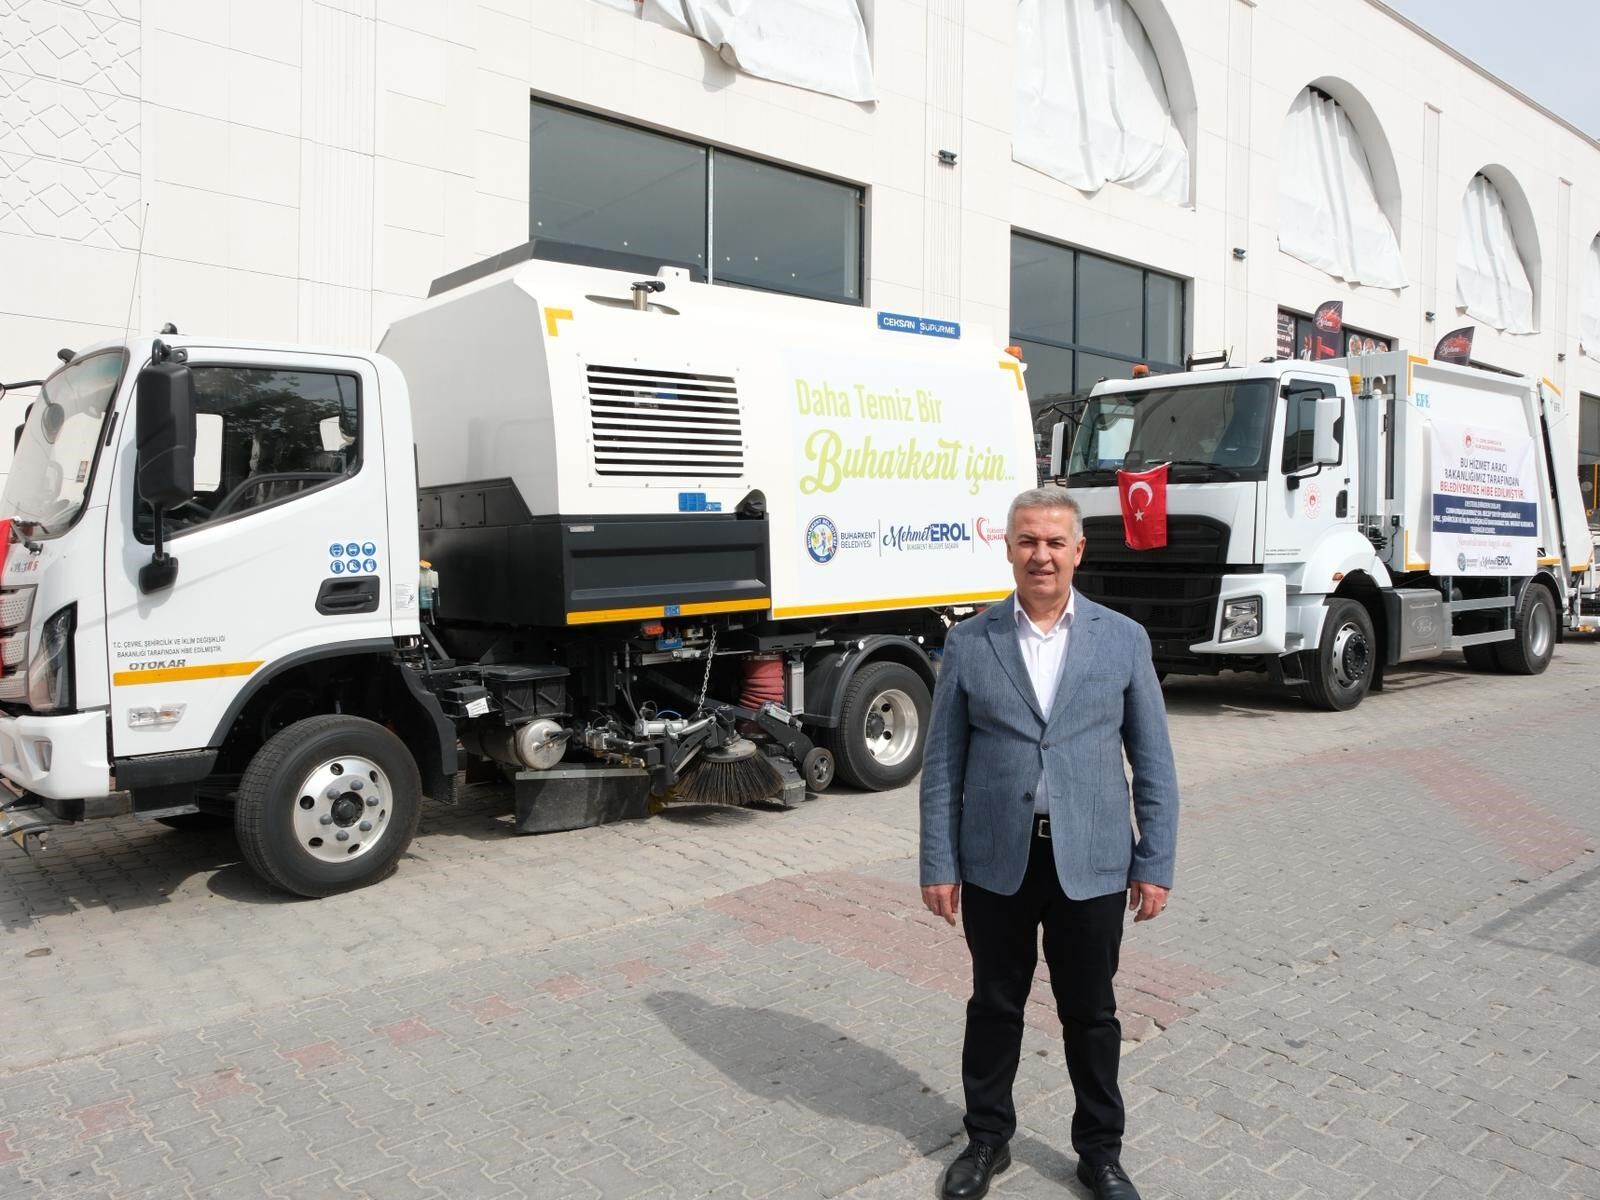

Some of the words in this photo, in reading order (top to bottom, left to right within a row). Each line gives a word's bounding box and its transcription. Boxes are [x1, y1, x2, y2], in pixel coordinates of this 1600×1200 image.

[795, 378, 851, 417] Daha
[853, 383, 914, 421] Temiz
[915, 388, 942, 424] Bir
[799, 428, 963, 496] Buharkent
[964, 446, 1015, 496] için...
[1460, 457, 1469, 468] BU
[1469, 457, 1490, 471] HİZMET
[1491, 461, 1508, 473] ARACI
[1487, 473, 1520, 487] TARAFINDAN
[840, 531, 876, 540] BUHARKENT
[882, 524, 932, 552] Mehmet
[930, 522, 971, 542] EROL
[986, 534, 1005, 542] BUHAR
[840, 540, 872, 549] BELEDİYESİ
[1496, 555, 1512, 566] EROL
[174, 638, 181, 646] VE
[147, 648, 180, 657] TARAFINDAN
[128, 659, 187, 671] OTOKAR
